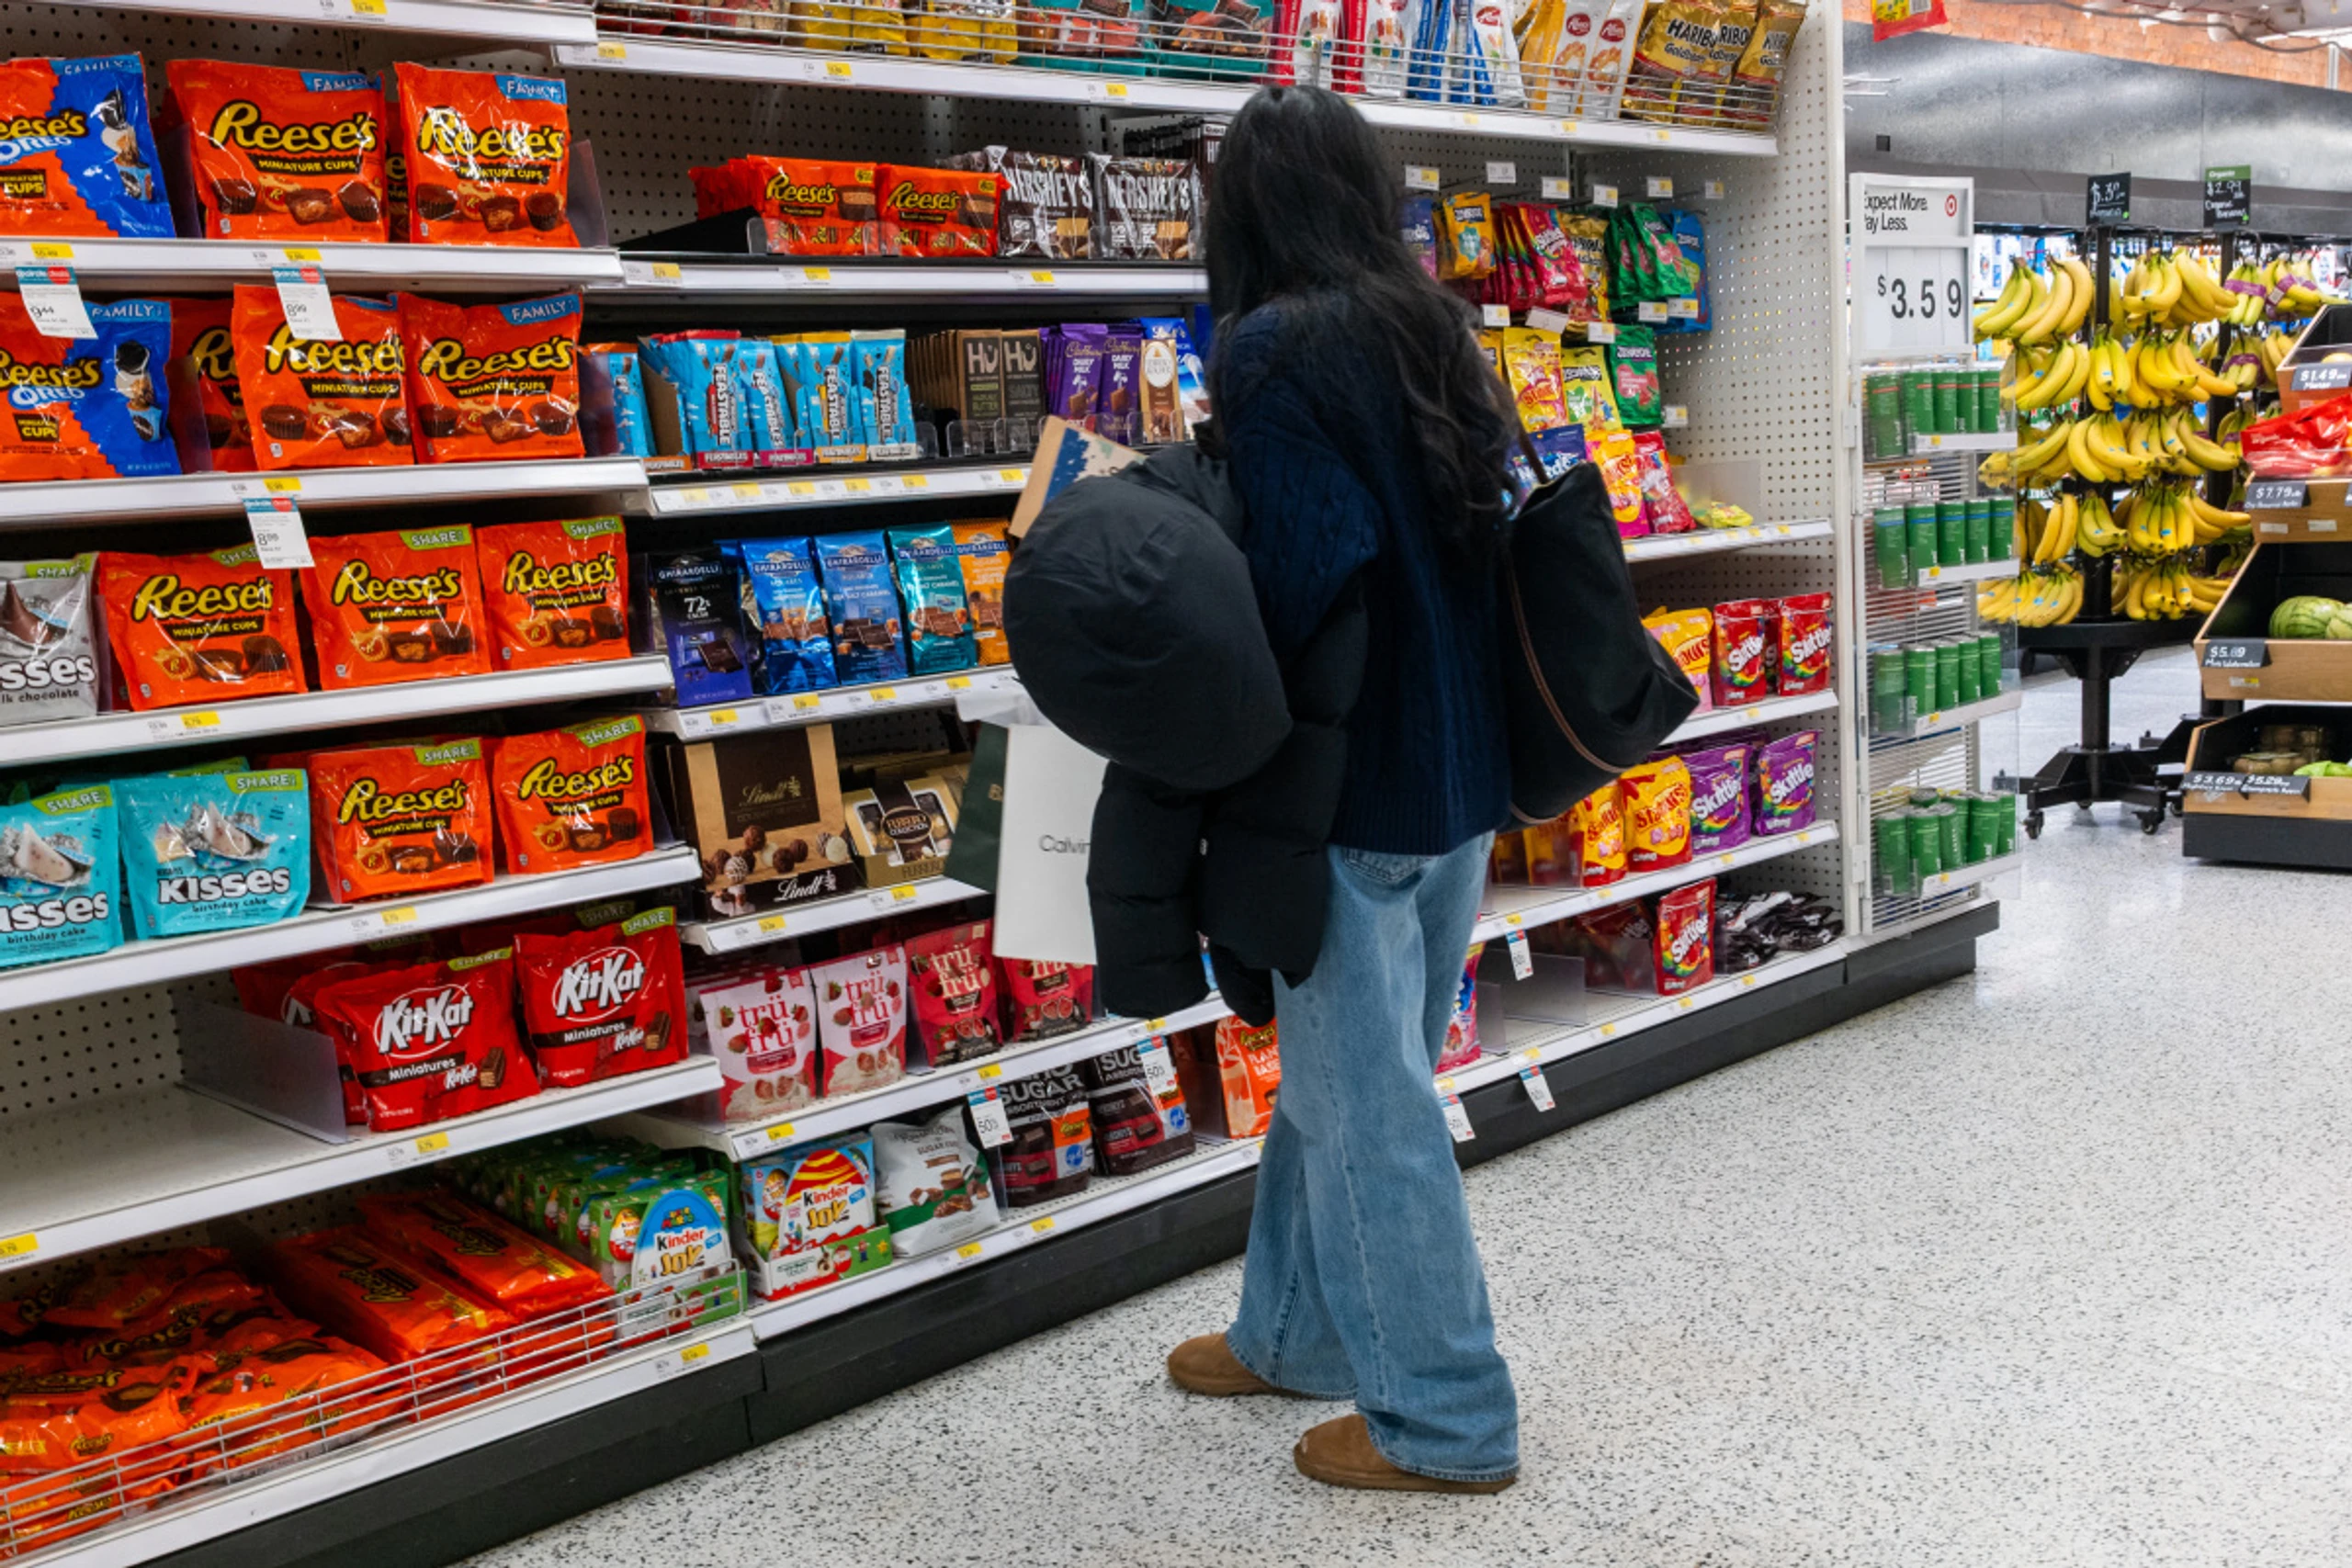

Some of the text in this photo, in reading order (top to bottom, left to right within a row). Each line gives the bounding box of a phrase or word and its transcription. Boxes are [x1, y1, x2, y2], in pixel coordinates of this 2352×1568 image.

[0, 110, 86, 138] eese's
[212, 101, 378, 151] Reese's
[418, 107, 564, 159] Reese's
[258, 159, 357, 172] MINIATURE CUPS
[5, 183, 44, 195] CUPS
[766, 174, 836, 204] Reese's
[887, 182, 959, 211] Reese's
[1005, 168, 1093, 209] HERSHEY'S
[1864, 191, 1898, 214] xpect
[92, 304, 154, 320] FAMILY
[512, 299, 568, 321] FAMILY
[420, 336, 575, 382] Reese's
[1072, 357, 1095, 367] DAIRY
[1111, 354, 1134, 364] DAIRY
[11, 384, 85, 406] OREO
[458, 379, 547, 396] MINIATURE CUPS
[411, 531, 458, 547] SHARE
[570, 521, 612, 536] SHARE
[505, 551, 617, 593] Reese's
[658, 565, 719, 580] GHIRARDELLI
[754, 560, 811, 574] GHIRARDELLI
[333, 559, 460, 605] Reese's
[132, 575, 274, 621] Reese's
[232, 620, 259, 631] CUPS
[2, 689, 80, 704] lk chocolate
[582, 722, 630, 744] SHARE
[423, 746, 469, 762] SHARE
[236, 775, 288, 790] SHARE
[519, 756, 633, 799] Reese's
[46, 791, 101, 812] SHARE
[339, 779, 466, 824] Reese's
[742, 782, 788, 807] Lindt
[776, 874, 824, 901] Lindt
[243, 897, 268, 907] cake
[627, 911, 666, 932] SHARE
[6, 927, 87, 945] birthday cake
[556, 953, 645, 1017] KitKat
[378, 987, 474, 1055] KitKat
[564, 1020, 627, 1043] Miniatures
[388, 1057, 457, 1082] Miniatures
[1100, 1047, 1143, 1072] SUG
[1000, 1072, 1085, 1103] SUGAR
[807, 1200, 848, 1231] JOY
